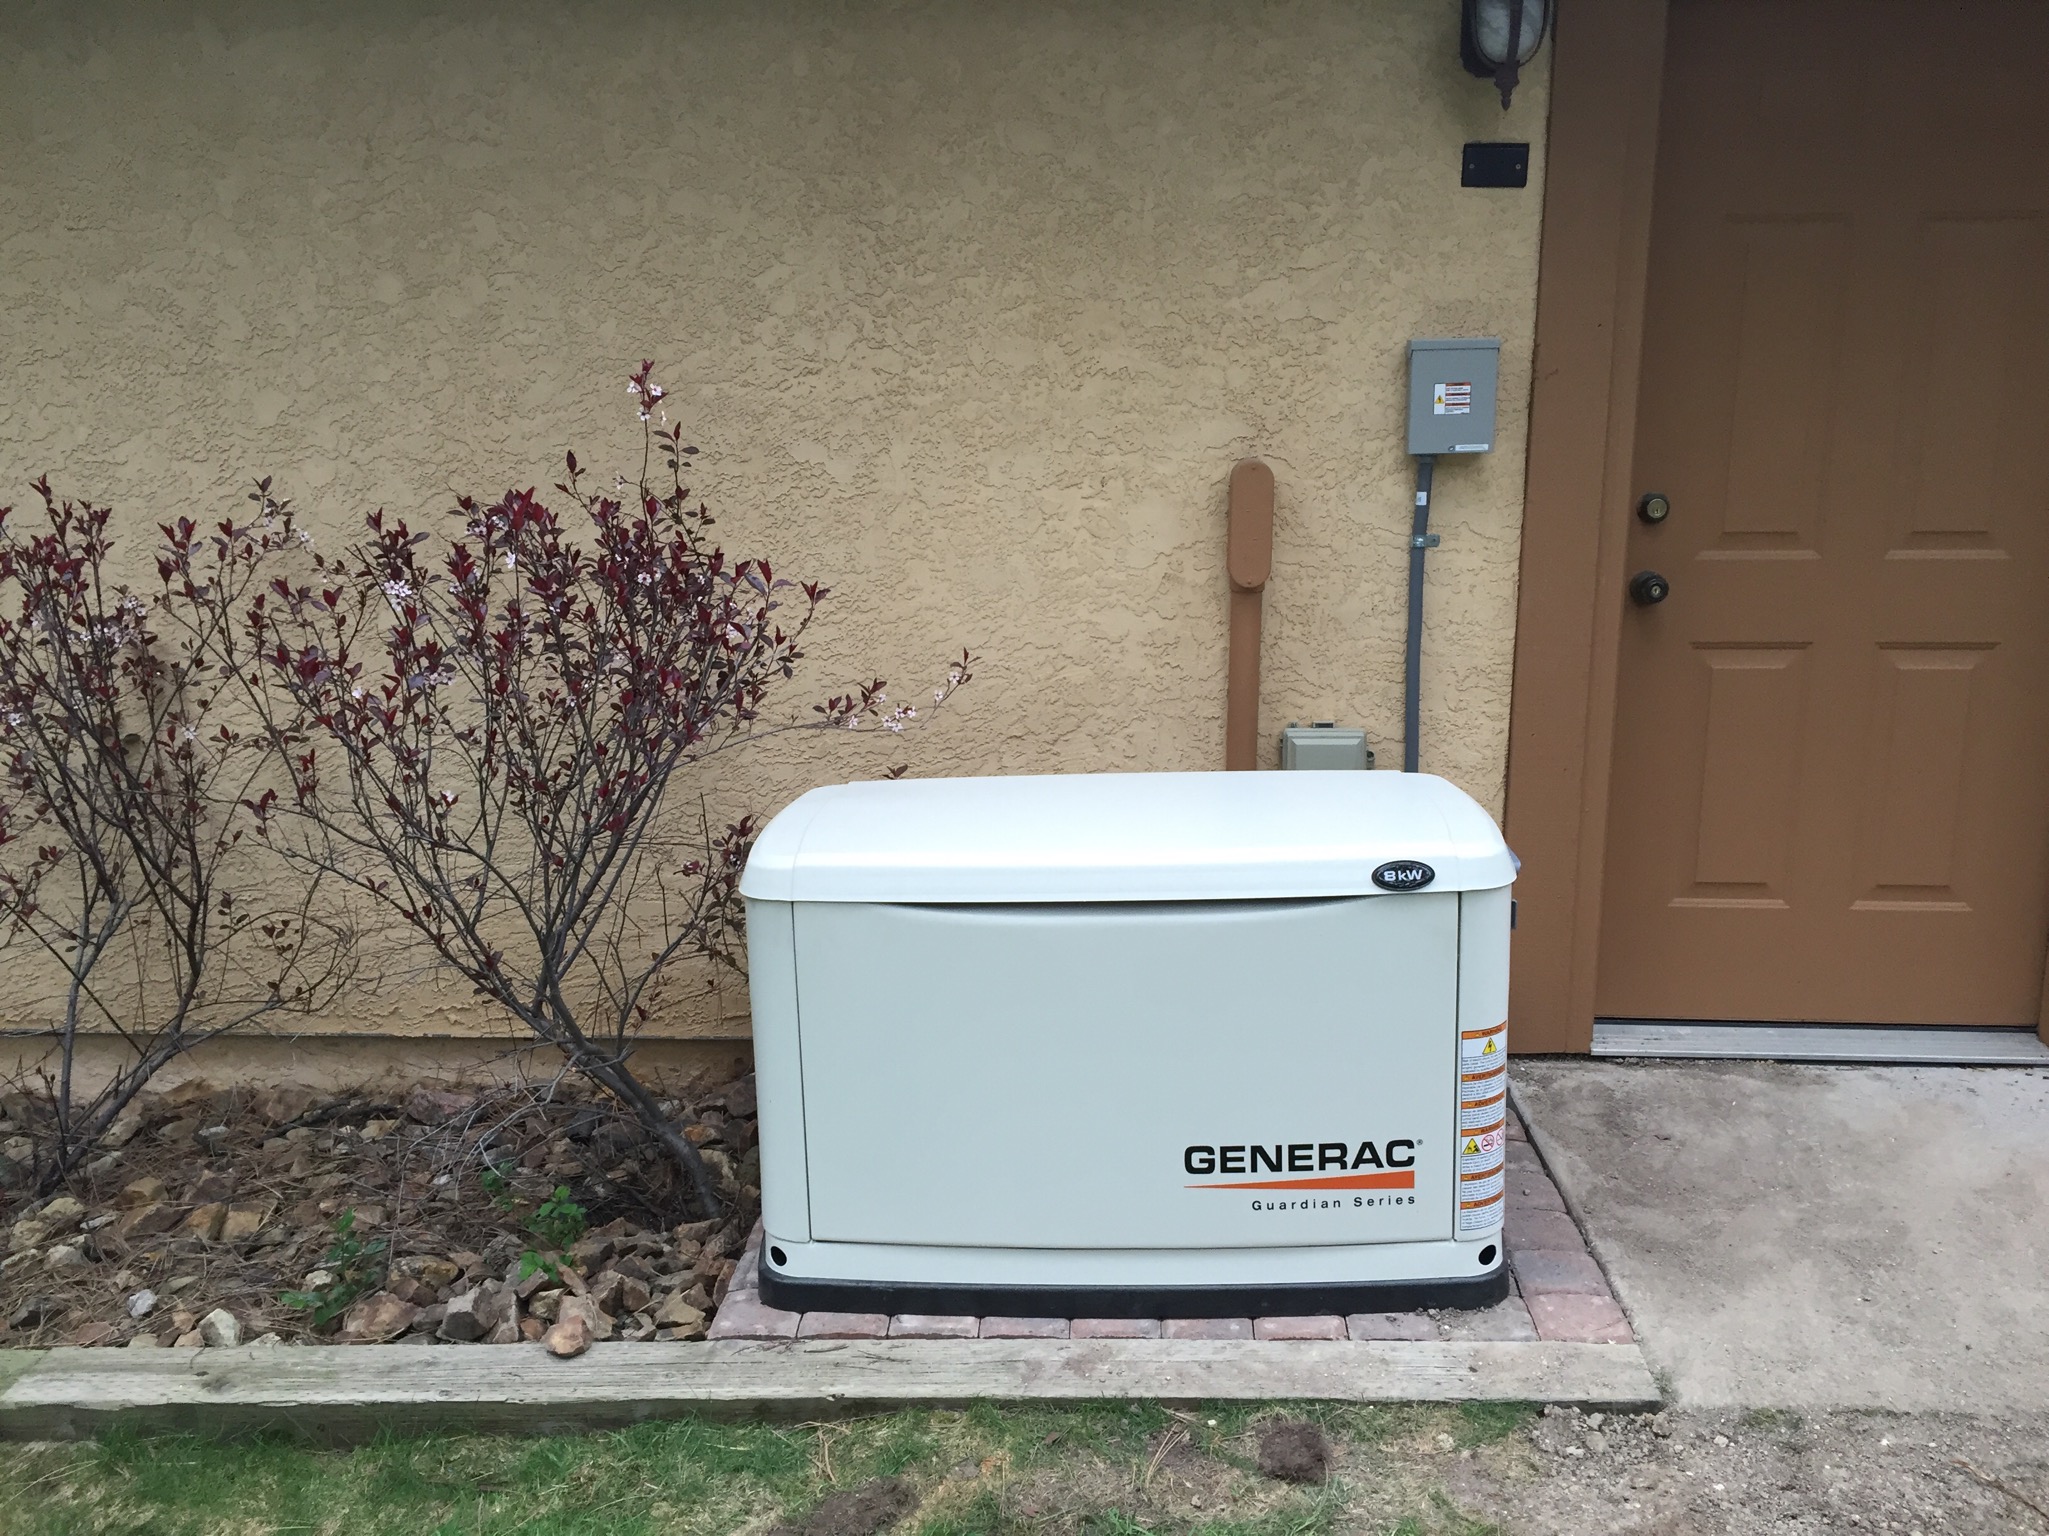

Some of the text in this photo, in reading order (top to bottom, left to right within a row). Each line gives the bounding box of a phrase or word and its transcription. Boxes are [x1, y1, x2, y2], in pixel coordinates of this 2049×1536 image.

[1184, 1139, 1415, 1175] GENERAC
[1251, 1196, 1416, 1211] Guardian Series
